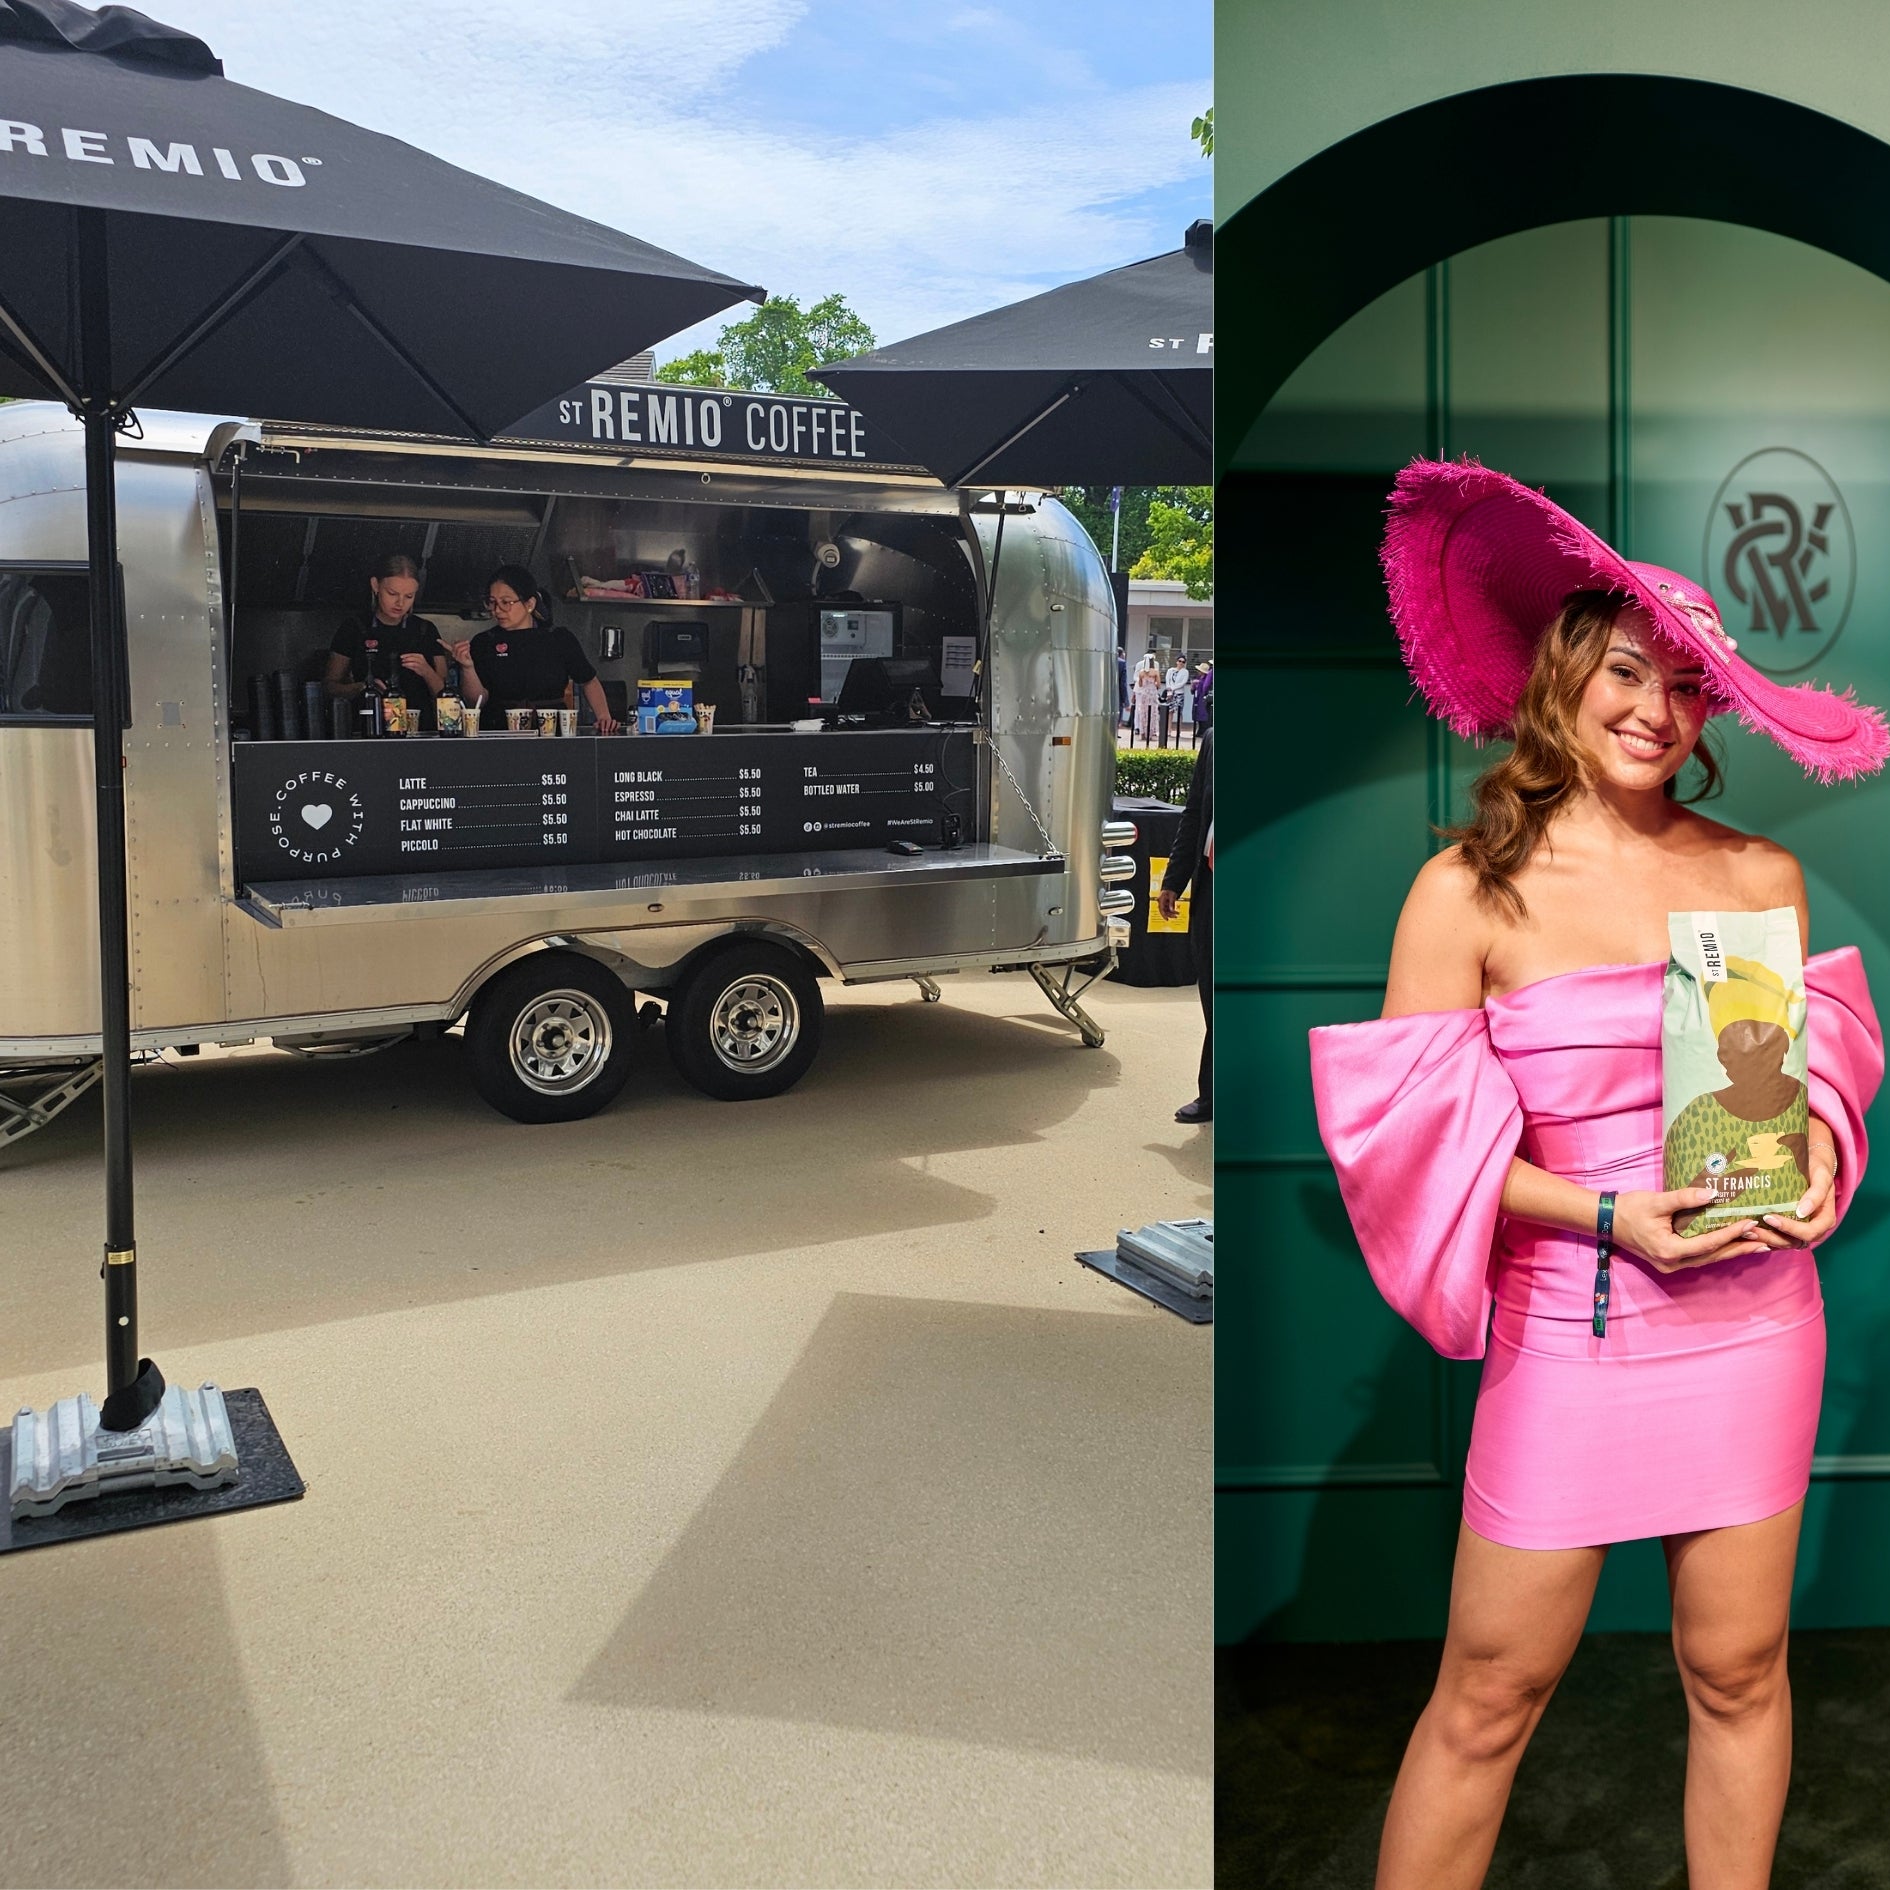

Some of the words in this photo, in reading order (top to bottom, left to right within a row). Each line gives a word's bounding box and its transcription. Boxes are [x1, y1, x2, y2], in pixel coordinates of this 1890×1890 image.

[1148, 338, 1185, 349] ST
[559, 400, 583, 425] ST
[746, 403, 866, 458] COFFEE
[614, 772, 635, 783] LONG
[637, 771, 663, 783] BLACK
[739, 768, 761, 779] $5.50
[803, 767, 817, 778] TEA
[913, 763, 934, 774] $4.50
[399, 778, 426, 790] LATTE
[541, 774, 567, 785] $5.50
[803, 785, 834, 796] BOTTLED
[836, 784, 860, 794] WATER
[913, 781, 934, 792] $5.00
[400, 797, 456, 811] CAPPUCCINO
[542, 794, 567, 805] $5.50
[615, 791, 655, 802] ESPRESSO
[739, 787, 761, 798] $5.50
[276, 771, 347, 801] COFFEE
[345, 793, 364, 846] WITH
[615, 811, 633, 822] CHAI
[636, 810, 659, 821] LATTE
[739, 806, 761, 817] $5.50
[400, 819, 422, 831] FLAT
[424, 818, 452, 831] WHITE
[542, 813, 568, 825] $5.50
[615, 830, 631, 841] HOT
[632, 828, 677, 840] CHOCOLATE
[739, 824, 761, 835] $5.50
[401, 839, 439, 851] PICCOLO
[543, 833, 568, 845] $5.50
[1699, 932, 1721, 967] REMIO
[1711, 969, 1720, 977] ST
[1705, 1177, 1719, 1190] ST
[1723, 1175, 1771, 1191] FRANCIS
